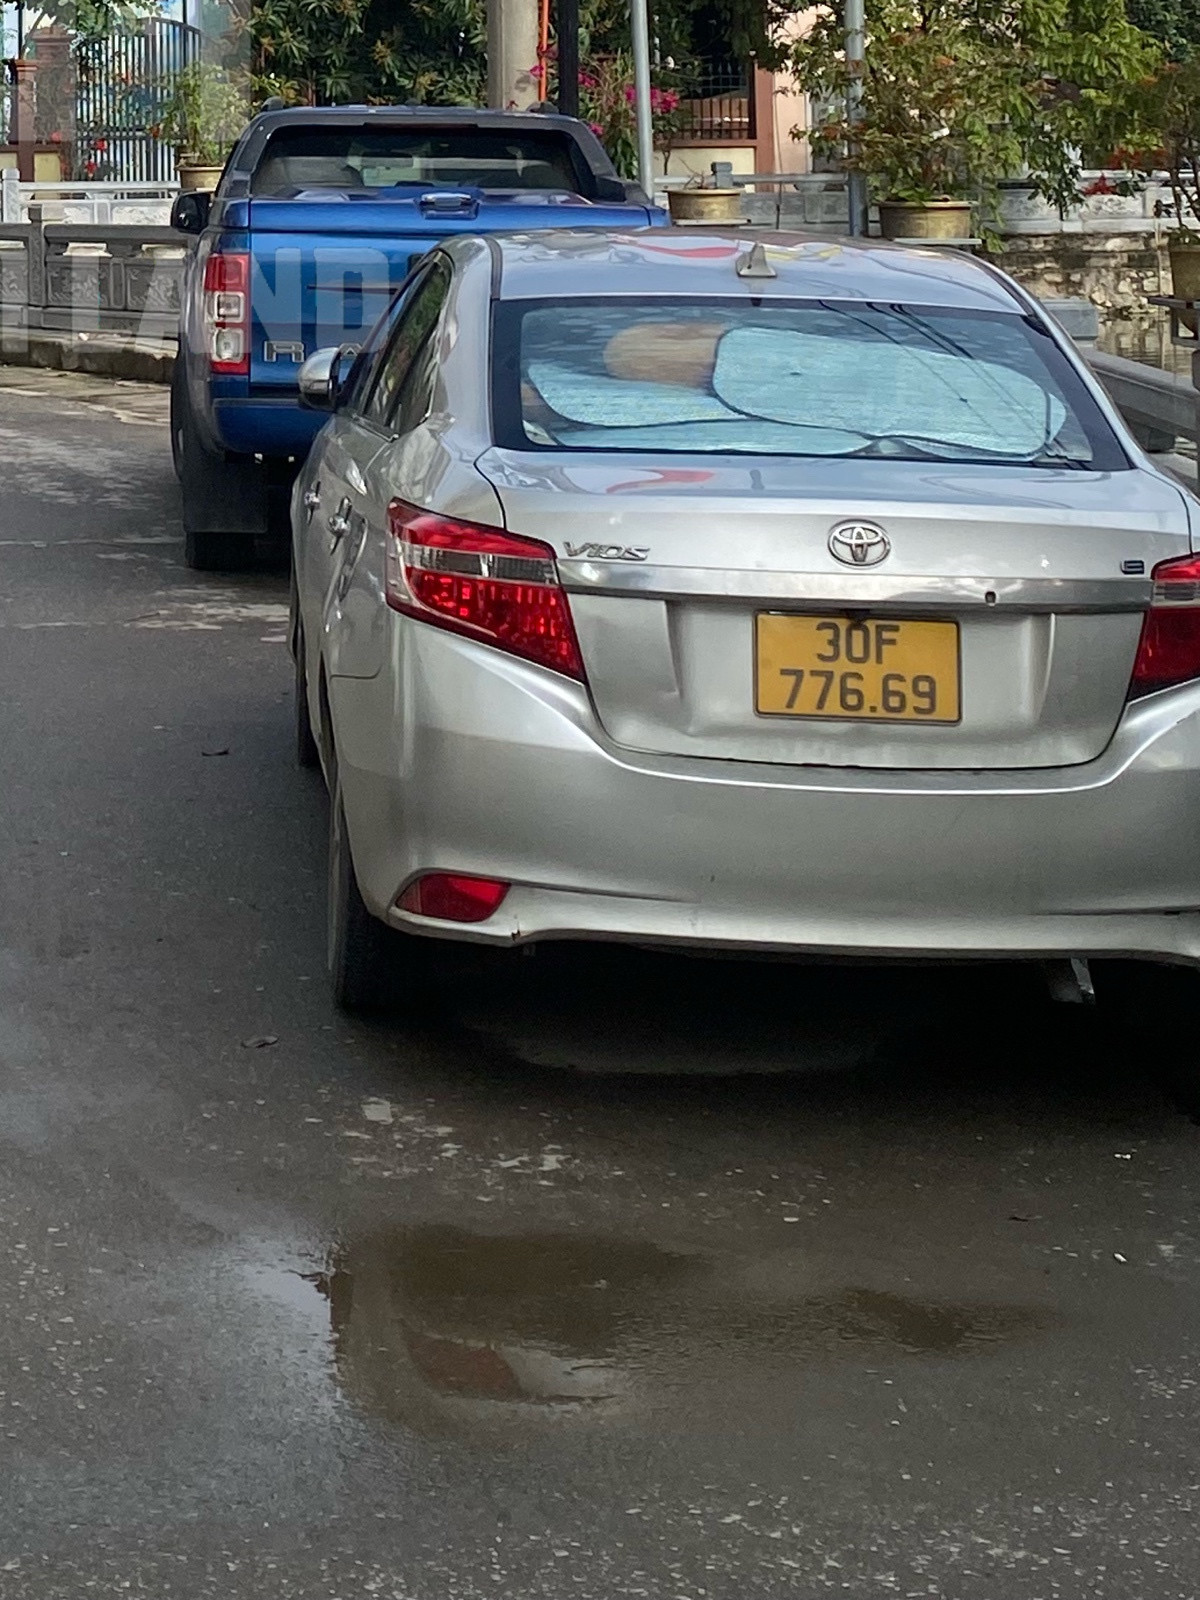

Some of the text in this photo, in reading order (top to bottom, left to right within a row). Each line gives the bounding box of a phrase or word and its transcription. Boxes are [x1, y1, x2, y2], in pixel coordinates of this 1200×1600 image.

[563, 541, 651, 561] VIOS
[816, 621, 901, 665] 30F
[779, 668, 937, 715] 776.69
